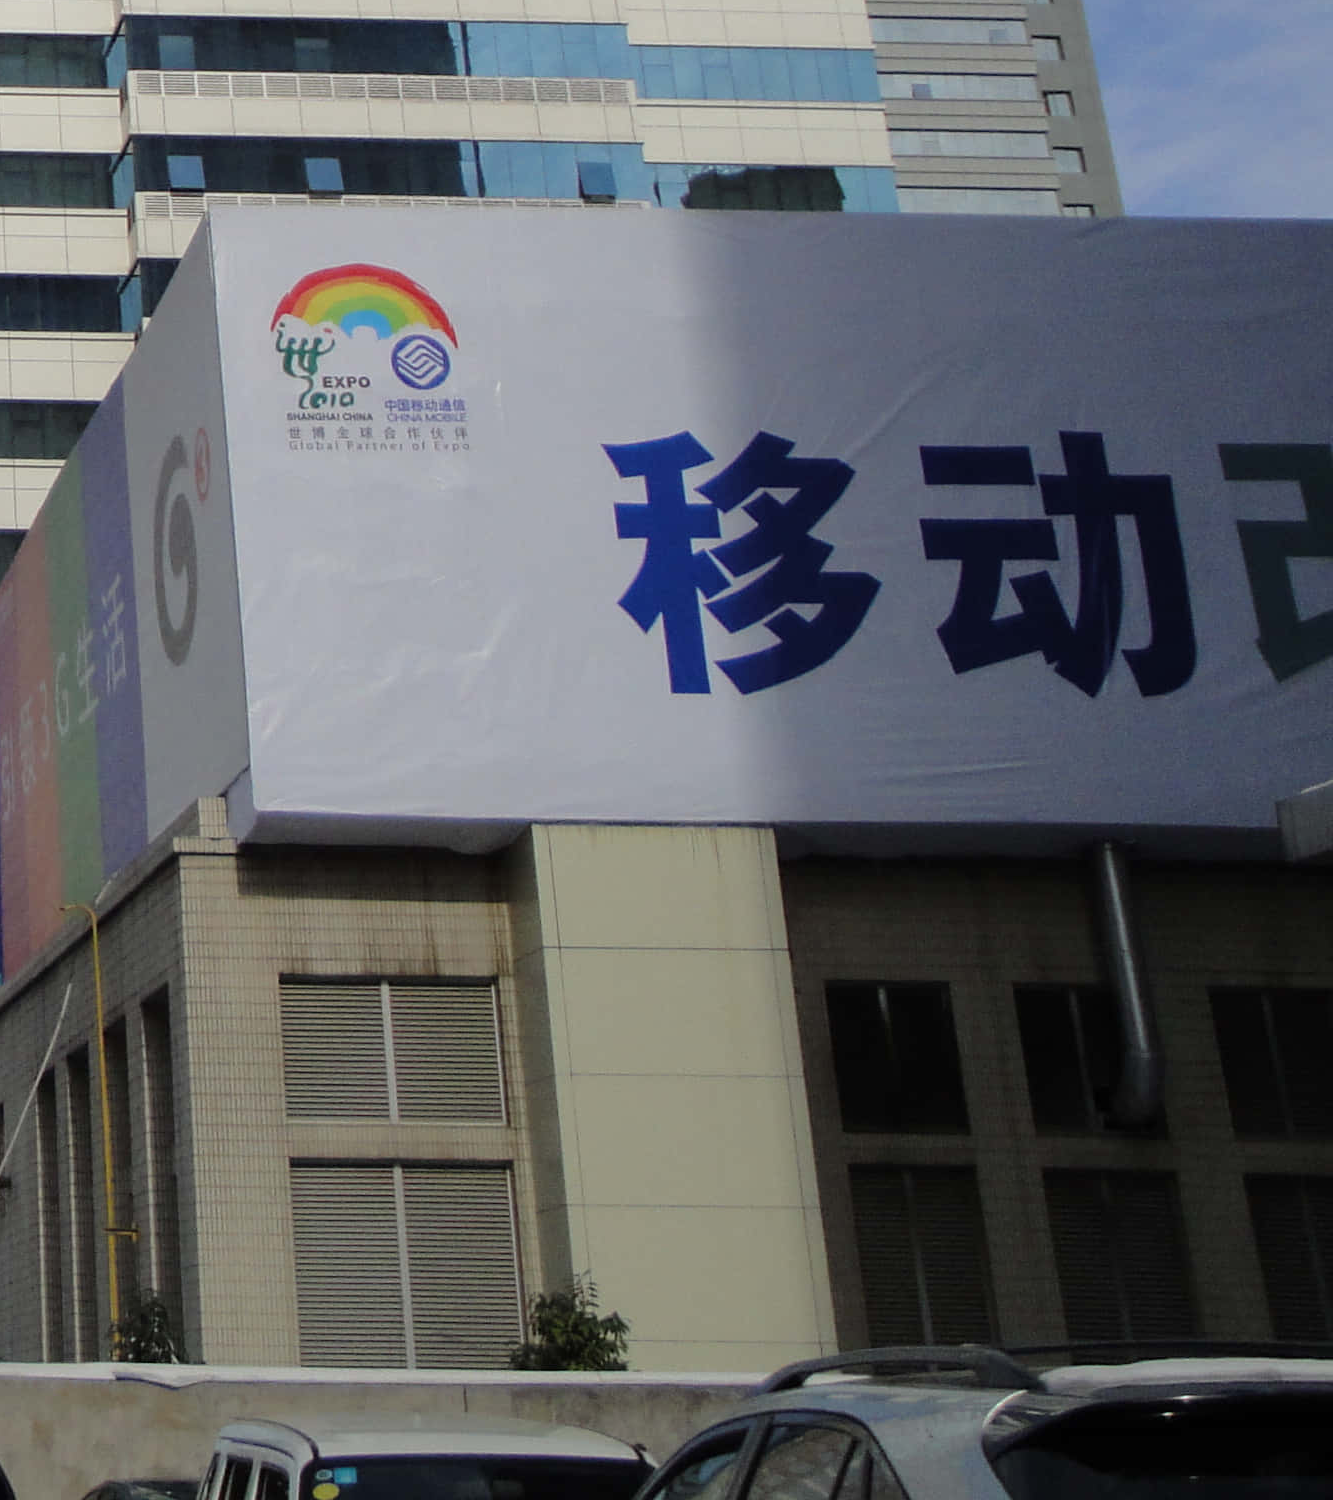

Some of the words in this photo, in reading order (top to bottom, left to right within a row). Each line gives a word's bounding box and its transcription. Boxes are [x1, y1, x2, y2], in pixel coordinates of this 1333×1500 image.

[322, 376, 371, 389] EXPO
[384, 398, 466, 412] 中国移动通信
[286, 412, 340, 421] SHANGHAI
[342, 412, 373, 421] CHINA
[386, 412, 423, 423] CHINA
[425, 412, 468, 423] MOBILE
[288, 426, 468, 441] 世博全球合作伙伴
